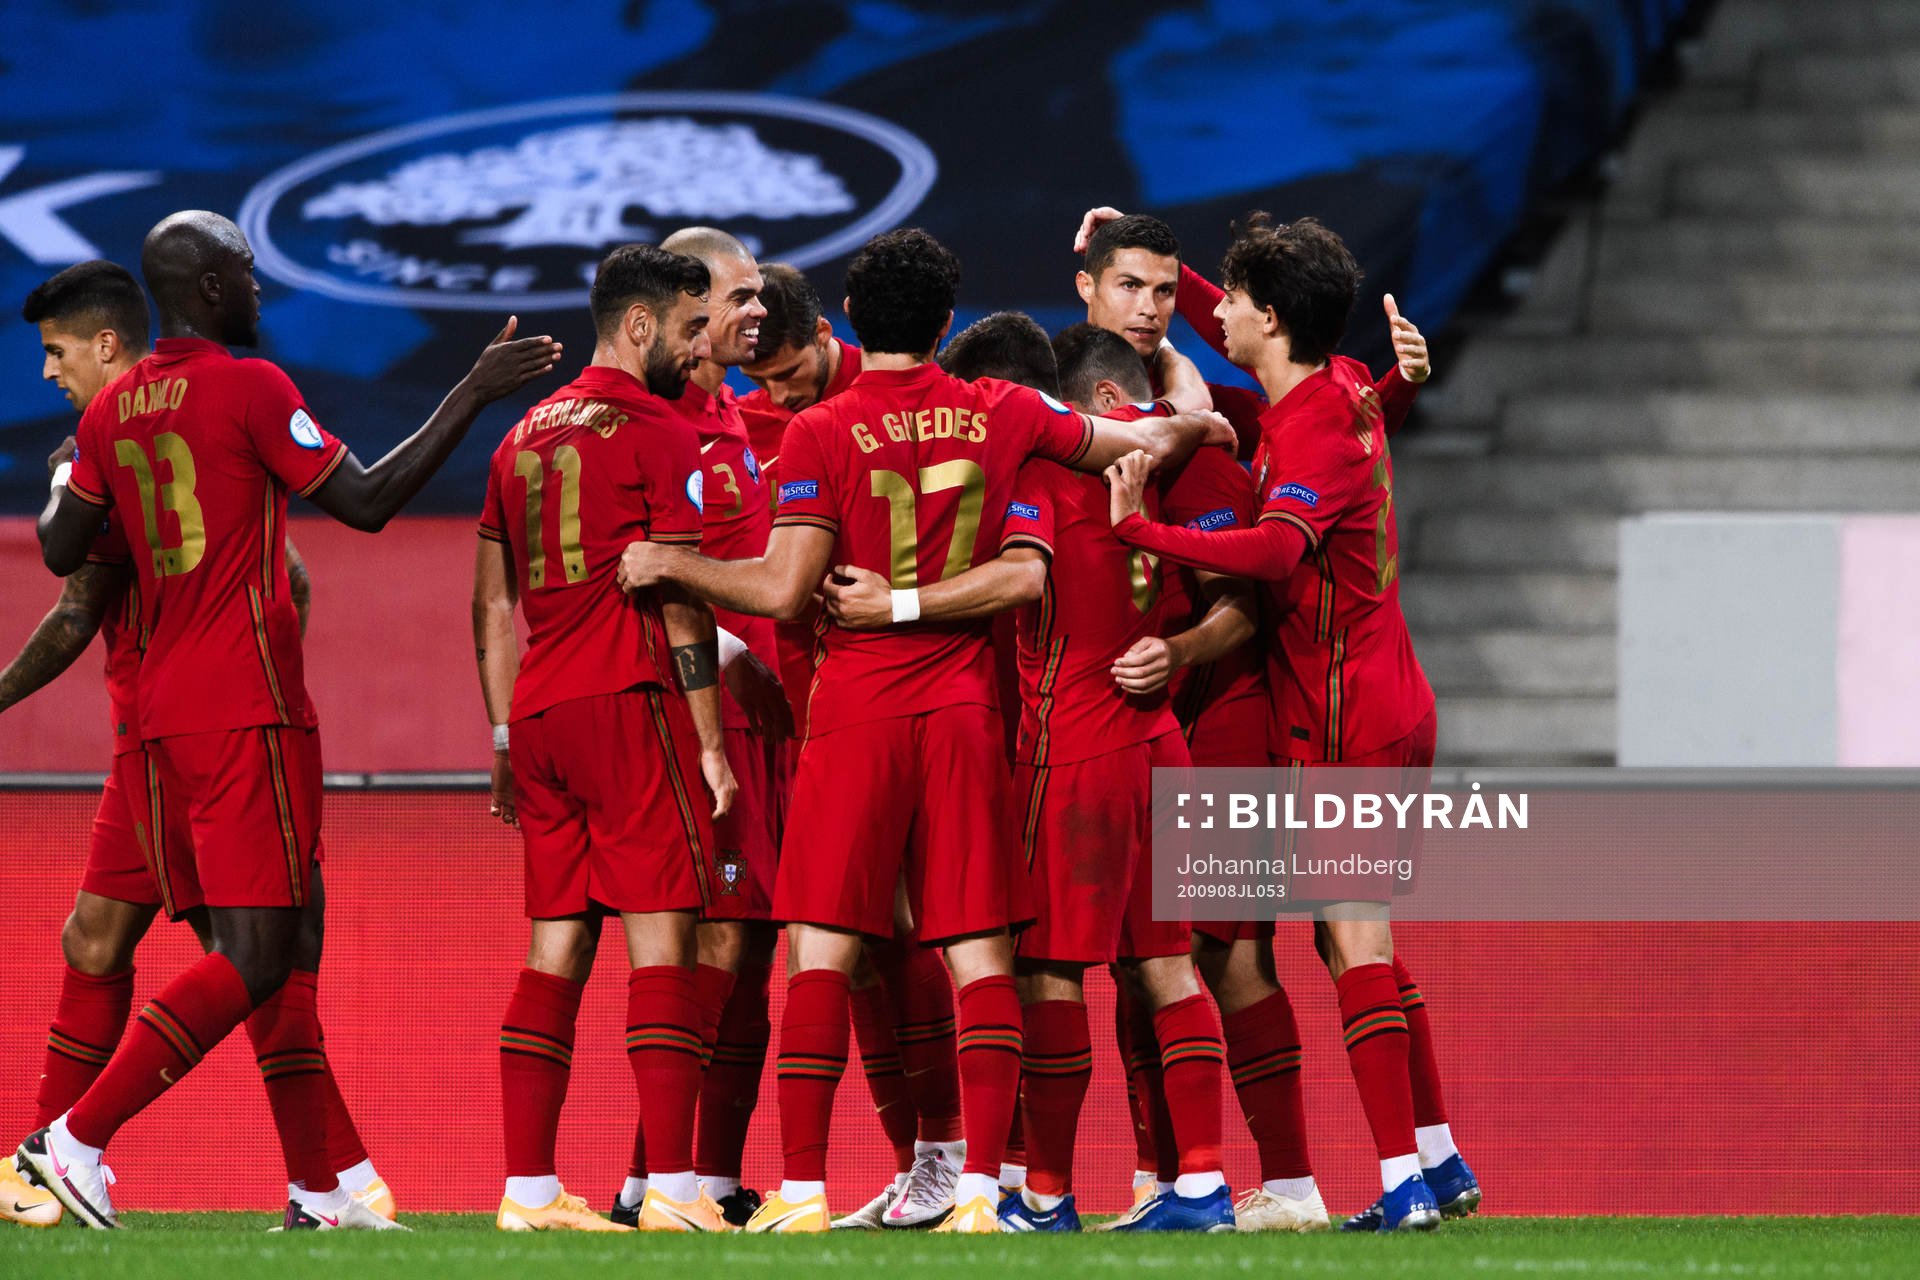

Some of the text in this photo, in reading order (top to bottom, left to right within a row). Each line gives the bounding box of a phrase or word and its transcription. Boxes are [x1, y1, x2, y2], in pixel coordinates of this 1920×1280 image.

[528, 398, 629, 440] FERNANDES
[851, 407, 987, 454] G. GUEDES
[114, 431, 206, 578] 13
[711, 463, 743, 518] 3
[1281, 486, 1319, 504] RESPECT
[514, 445, 589, 590] 11
[870, 458, 986, 590] 17
[1200, 511, 1236, 529] RESPECT
